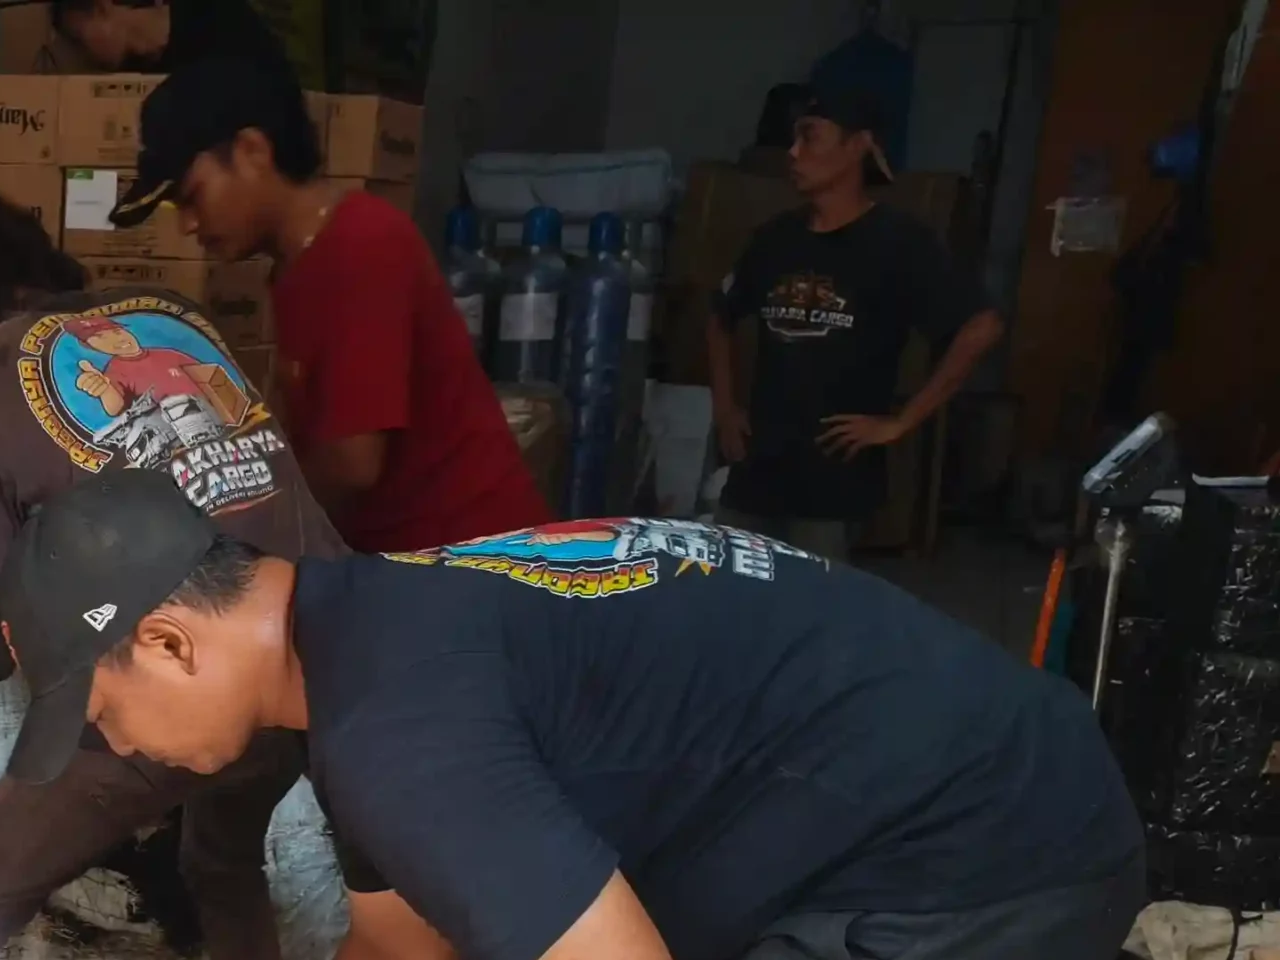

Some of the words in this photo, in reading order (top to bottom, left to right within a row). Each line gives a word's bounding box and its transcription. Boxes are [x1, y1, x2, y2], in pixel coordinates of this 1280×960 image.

[17, 357, 114, 473] JAGONYA
[171, 429, 285, 488] AKHARYA
[185, 461, 273, 508] CARGO
